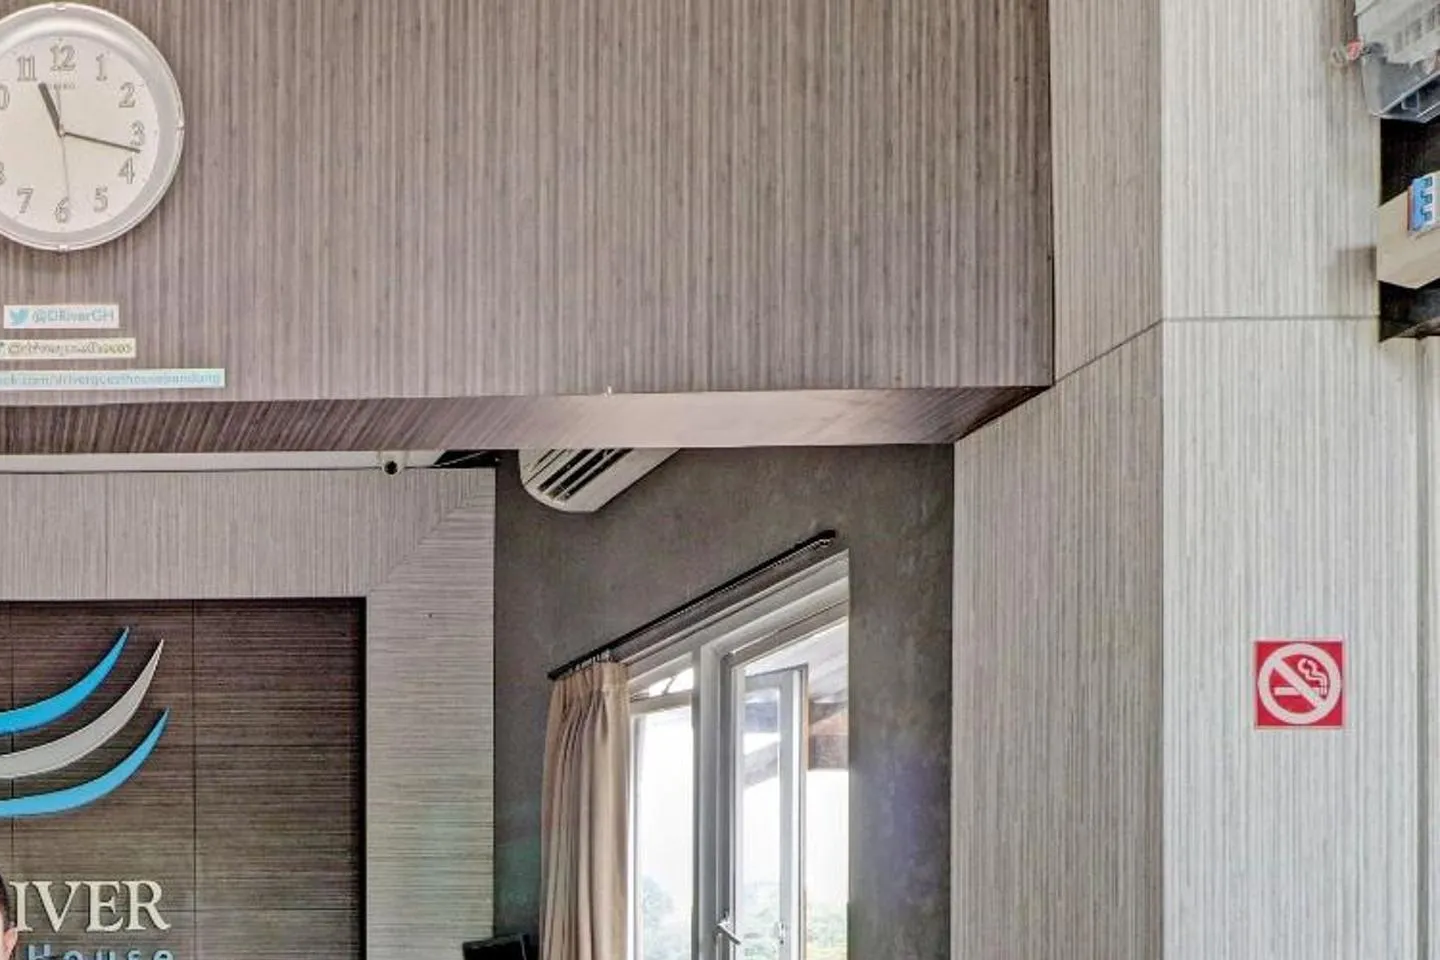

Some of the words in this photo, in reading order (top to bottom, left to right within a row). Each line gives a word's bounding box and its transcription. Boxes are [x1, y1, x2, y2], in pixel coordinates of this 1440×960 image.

[16, 55, 37, 82] 11
[49, 45, 77, 71] 12
[95, 54, 108, 81] 1
[118, 82, 136, 108] 2
[130, 121, 146, 146] 3
[118, 157, 136, 184] 4
[16, 188, 34, 214] 7
[55, 197, 71, 223] 6
[93, 187, 109, 213] 5
